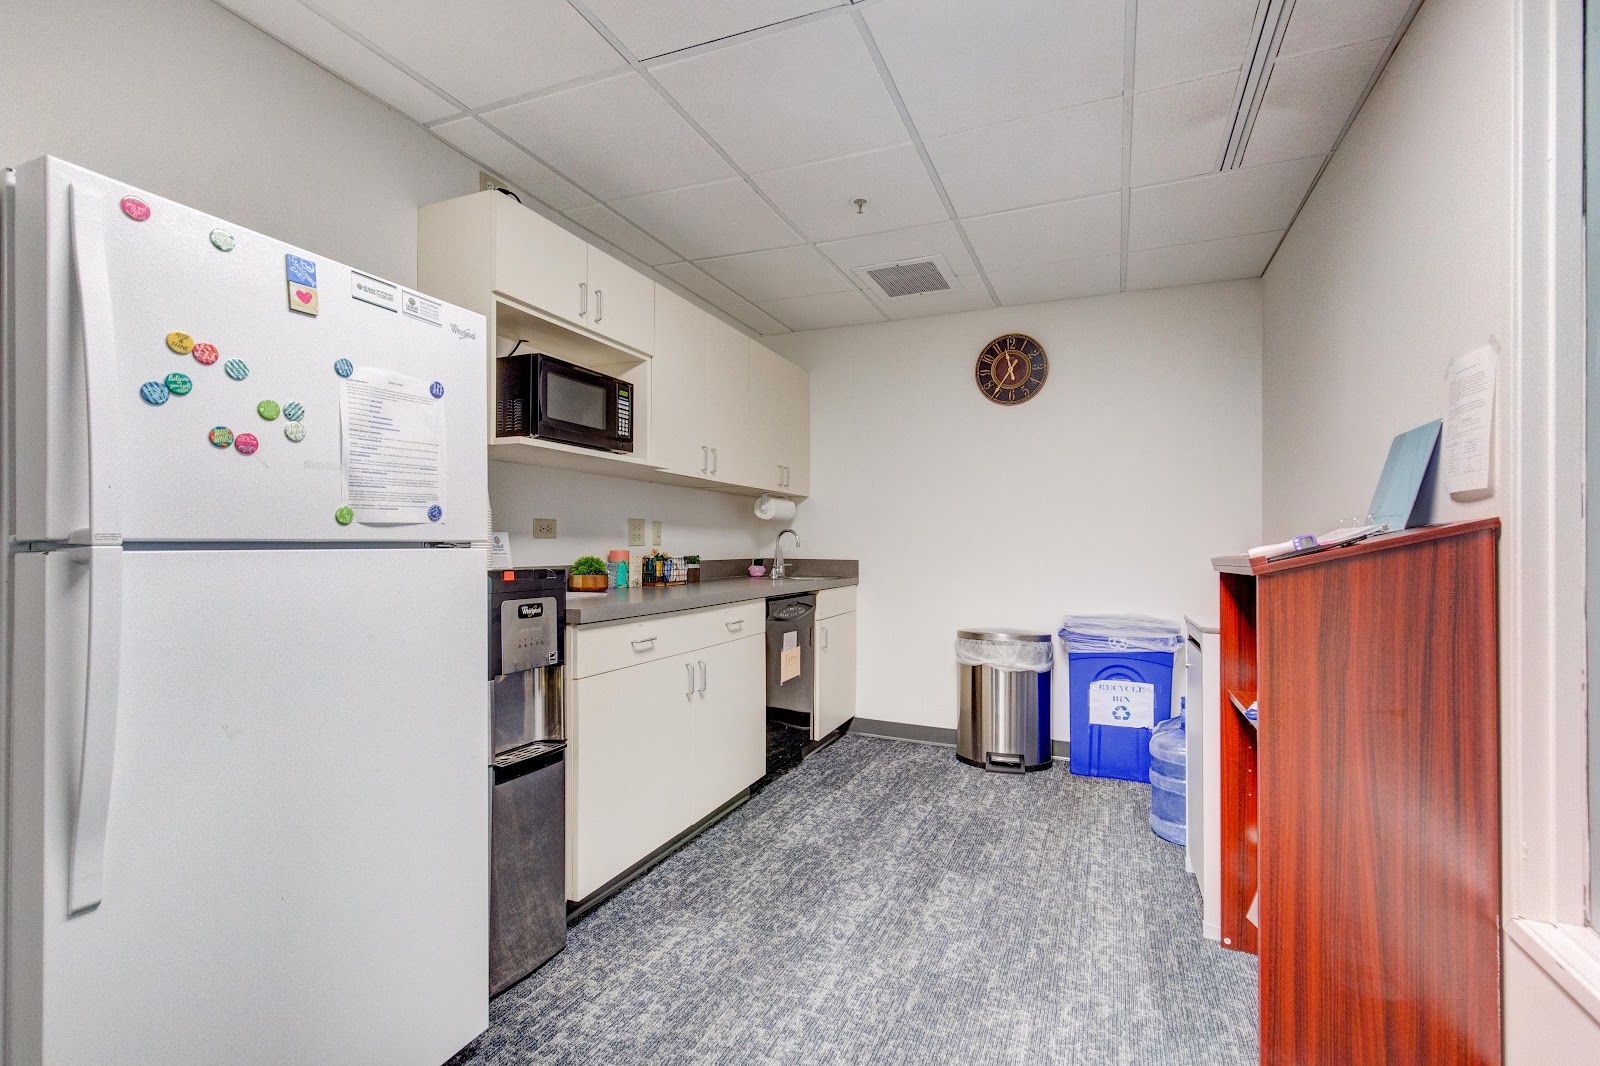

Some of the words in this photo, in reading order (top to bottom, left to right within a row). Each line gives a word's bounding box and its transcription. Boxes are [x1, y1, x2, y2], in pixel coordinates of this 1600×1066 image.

[175, 332, 190, 341] RISE
[450, 323, 476, 340] Whirlpool
[171, 341, 189, 351] SHINE
[992, 343, 1002, 354] 11
[1006, 338, 1016, 350] 12
[982, 354, 995, 364] 10
[983, 381, 995, 390] 8
[1008, 389, 1016, 401] 6
[521, 605, 542, 617] Whirlpool
[1098, 684, 1145, 693] RECYCLE
